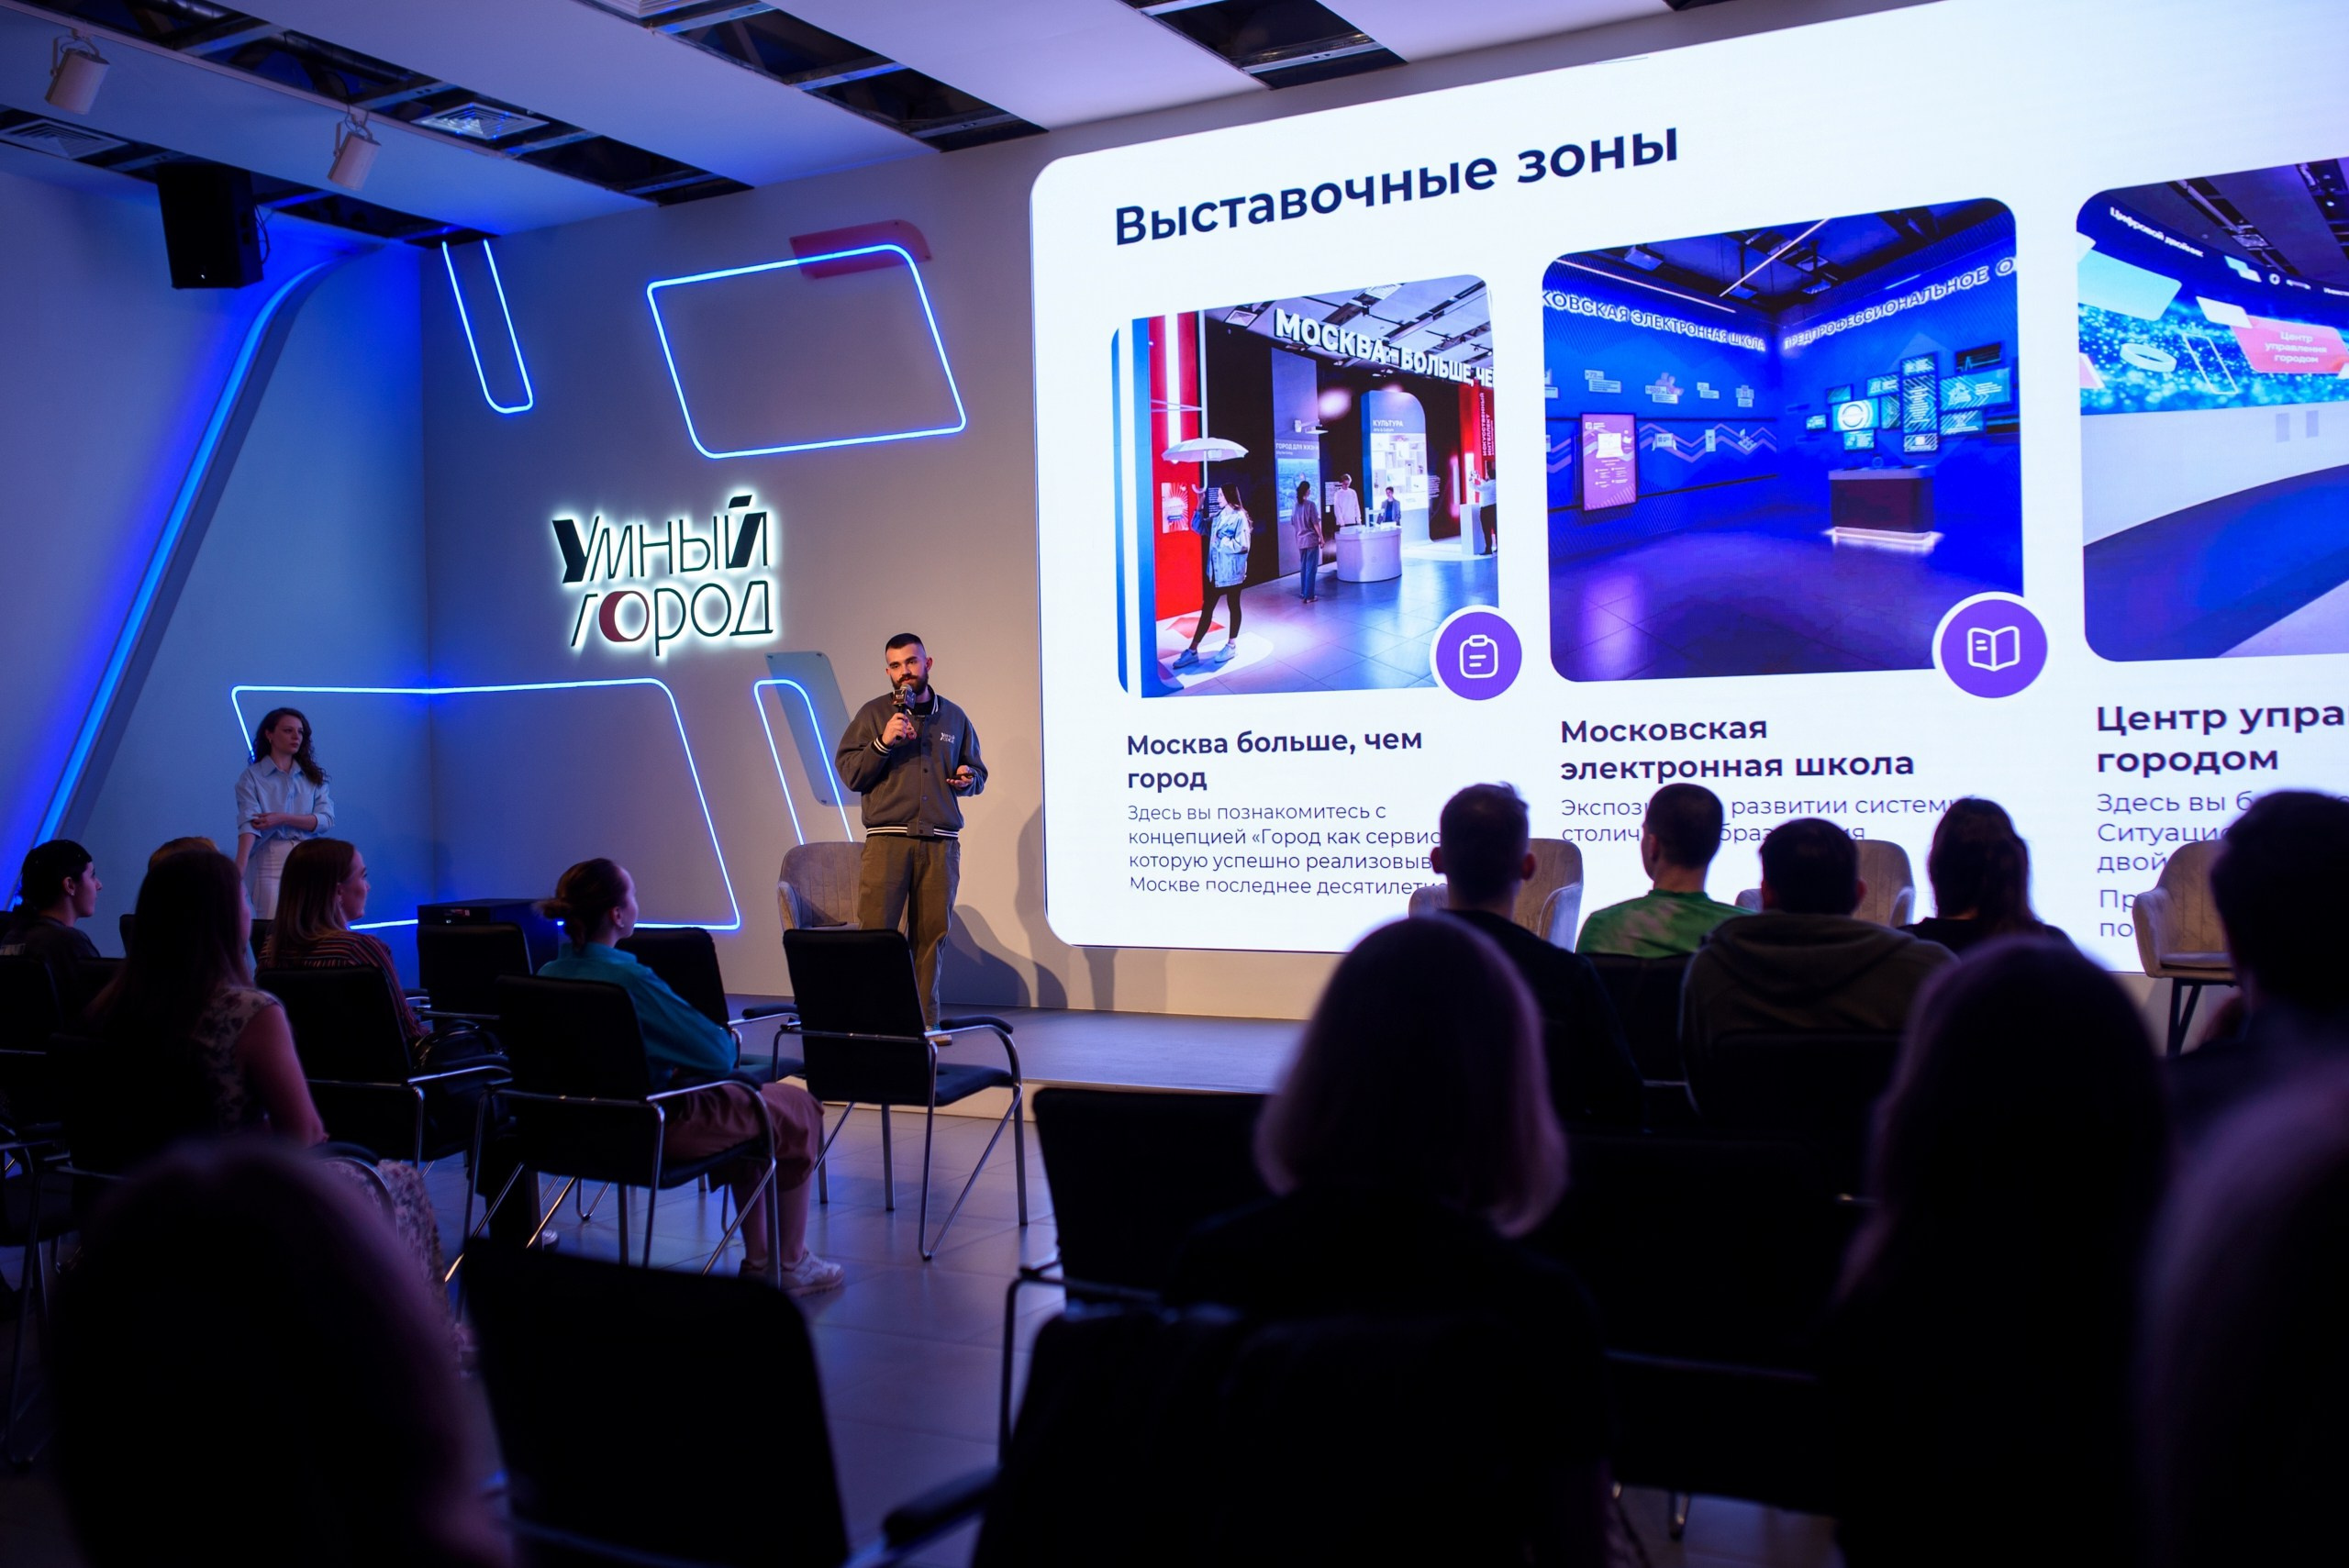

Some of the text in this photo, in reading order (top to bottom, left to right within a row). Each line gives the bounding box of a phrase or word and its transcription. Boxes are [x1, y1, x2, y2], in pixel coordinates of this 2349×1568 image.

[1116, 127, 1678, 246] Выставочные зоны
[1784, 265, 1990, 349] ПРЕДПРОФЕССИОНАЛЬНОЕ
[1631, 311, 1728, 343] ЭЛЕКТРОННАЯ
[1728, 332, 1766, 351] ШКОЛА
[2280, 331, 2313, 343] Центр
[1275, 308, 1386, 364] МОСКВА
[1401, 348, 1475, 386] БОЛЬШЕ,
[2275, 354, 2319, 363] городом
[1373, 419, 1404, 428] КУЛЬТУРА
[552, 495, 768, 584] УМНЫЙ
[571, 581, 774, 657] ГОРОД
[2098, 705, 2349, 735] Центр упра
[1561, 720, 1767, 743] Московская
[1127, 730, 1422, 755] Москва больше, чем
[1561, 756, 1914, 784] электронная школа
[2098, 750, 2278, 778] городом
[1128, 772, 1208, 793] город
[1128, 805, 1386, 820] Здесь вы познакомитесь с
[1732, 800, 1847, 817] развитии
[2097, 794, 2180, 814] Здесь
[2189, 796, 2225, 811] вы
[1129, 828, 1246, 847] концепцией
[1252, 828, 1321, 848] «Город
[1328, 831, 1361, 844] как
[1563, 828, 1640, 841] столич
[1130, 855, 1431, 872] которую успешно реализовыв
[2098, 852, 2166, 873] двой
[1130, 877, 1447, 895] Москве последнее десятилет
